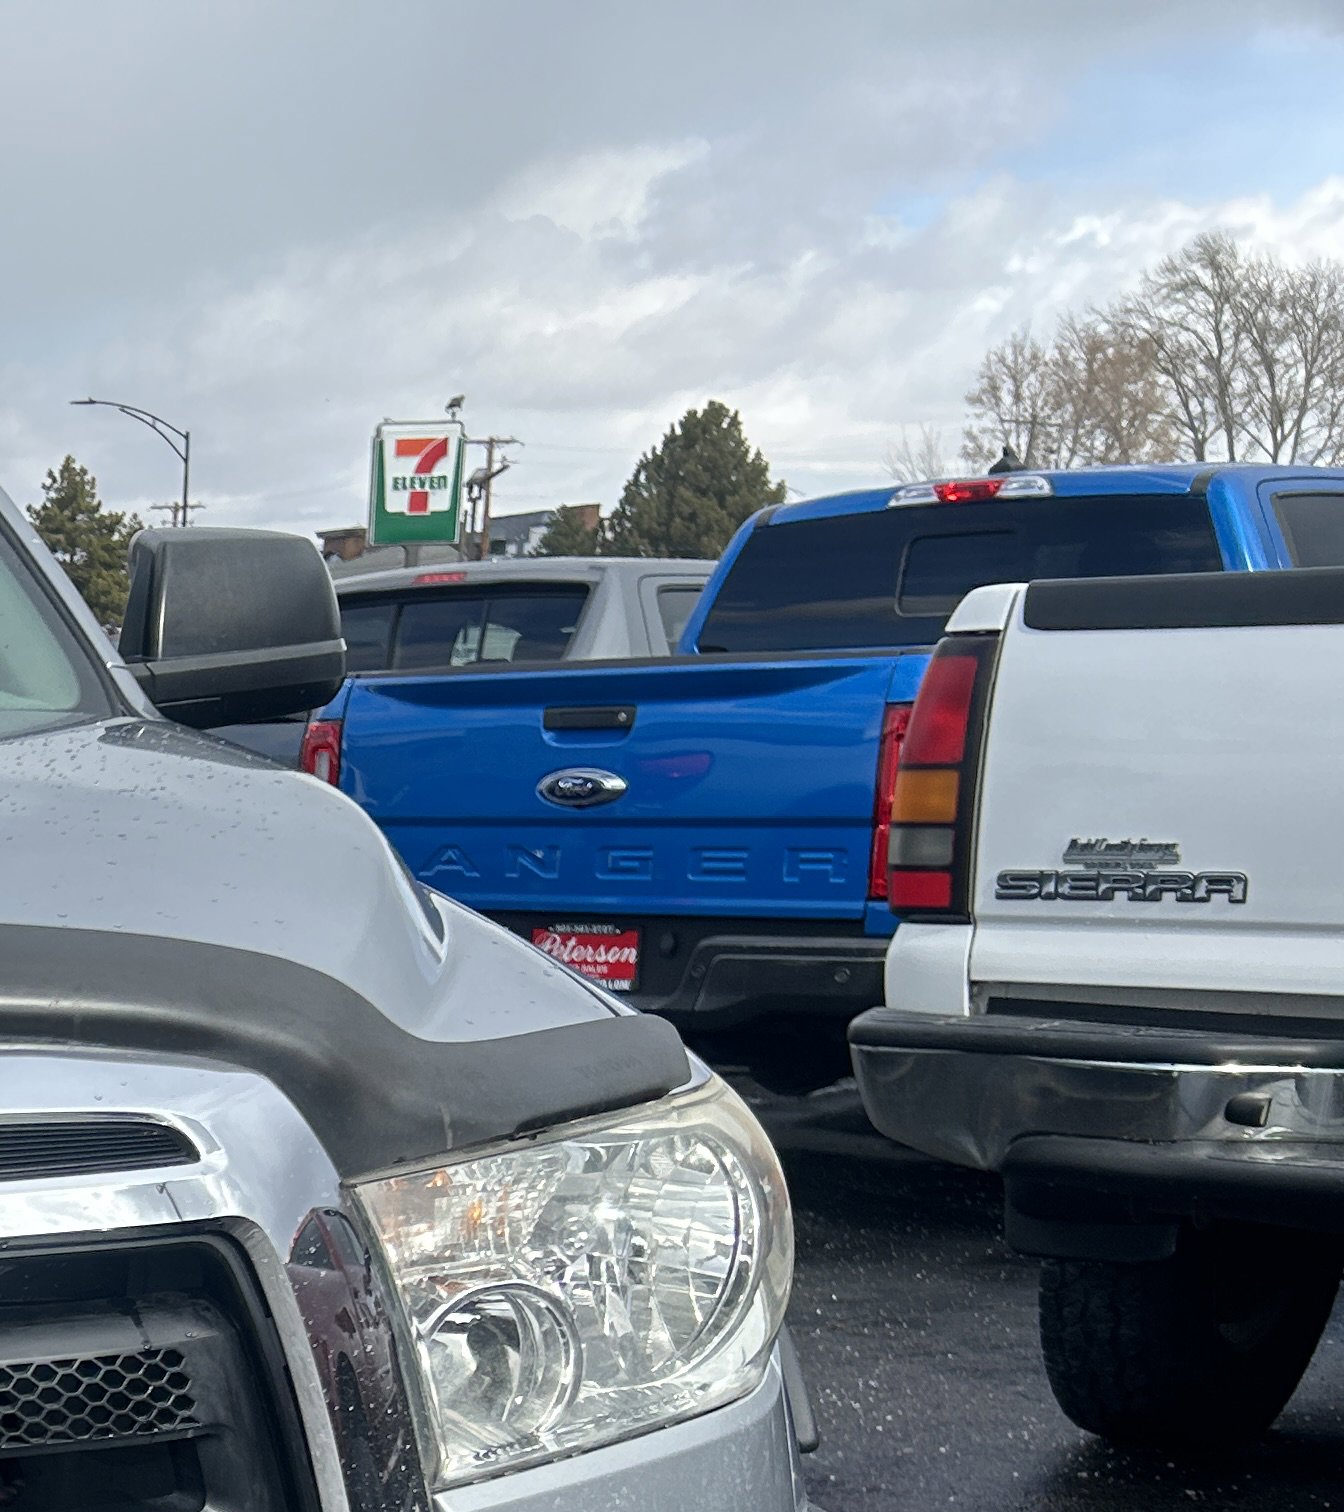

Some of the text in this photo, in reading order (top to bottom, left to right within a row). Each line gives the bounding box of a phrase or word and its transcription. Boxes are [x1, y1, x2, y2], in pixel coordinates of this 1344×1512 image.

[396, 438, 448, 513] 7
[417, 846, 846, 881] ANGER
[995, 869, 1248, 904] SIERRA
[534, 933, 638, 964] Peterson
